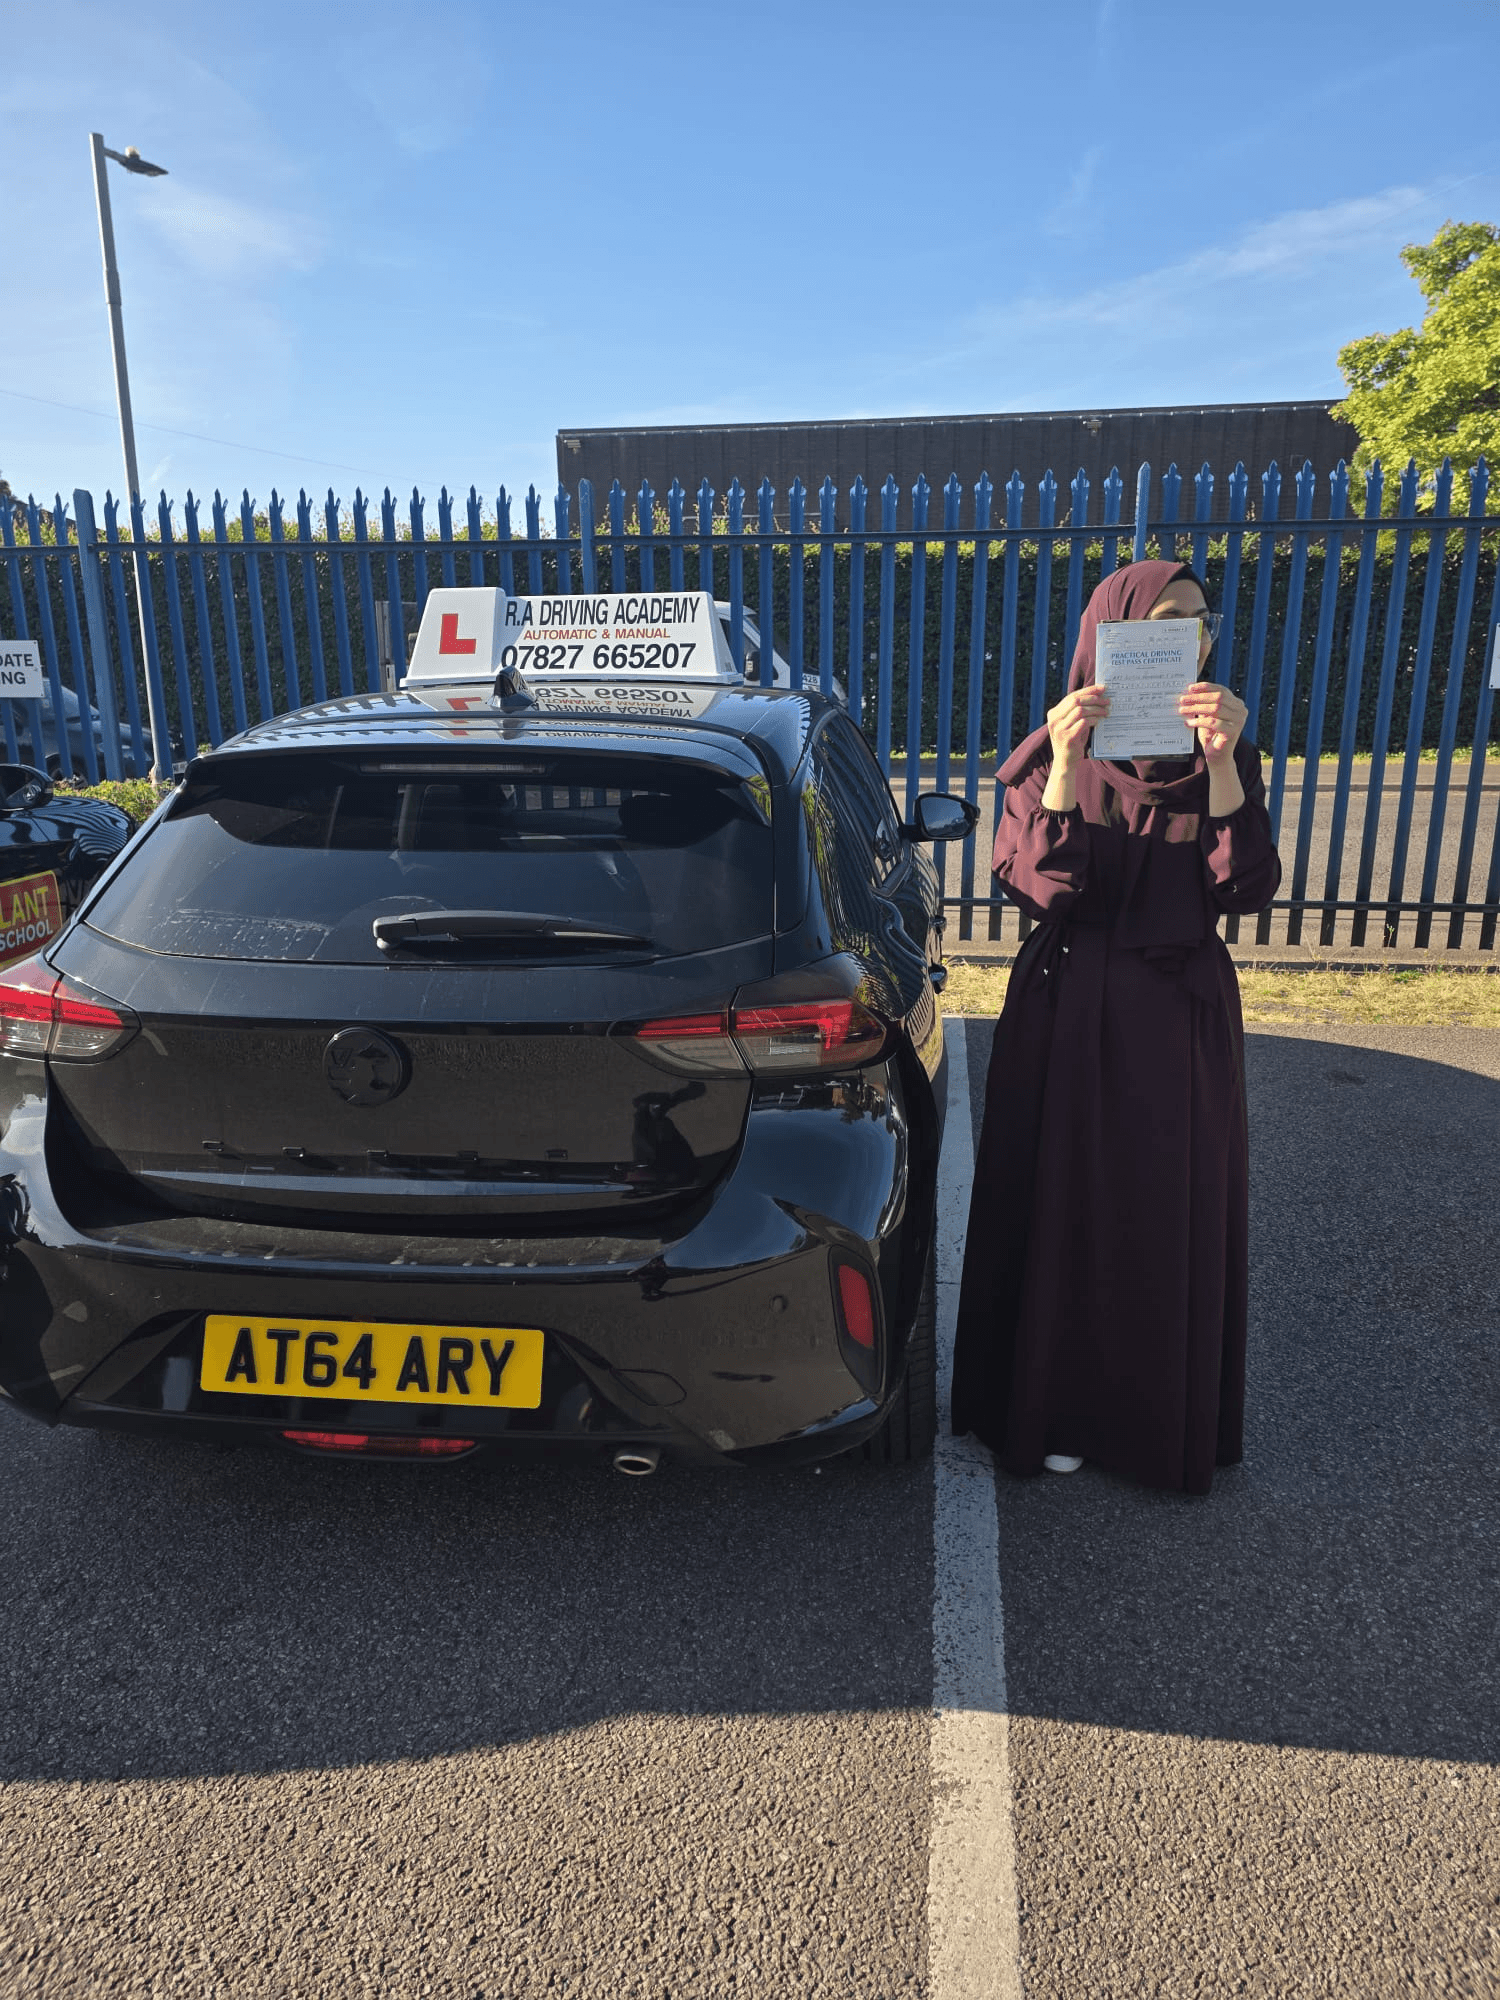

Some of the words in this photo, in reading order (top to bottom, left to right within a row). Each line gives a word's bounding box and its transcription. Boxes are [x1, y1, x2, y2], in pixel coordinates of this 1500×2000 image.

[505, 600, 533, 626] R.A
[539, 599, 609, 626] DRIVING
[613, 597, 700, 625] ACADEMY
[439, 613, 477, 655] L
[523, 629, 598, 641] AUTOMATIC
[602, 629, 611, 640] &
[615, 628, 671, 640] MANUAL
[501, 644, 584, 670] 07827
[593, 643, 697, 669] 665207
[1111, 651, 1149, 660] PRACTICAL
[1150, 649, 1182, 658] DRIVING
[1143, 656, 1181, 664] CERTIFICATE
[225, 1327, 377, 1389] AT64
[396, 1335, 515, 1396] ARY
